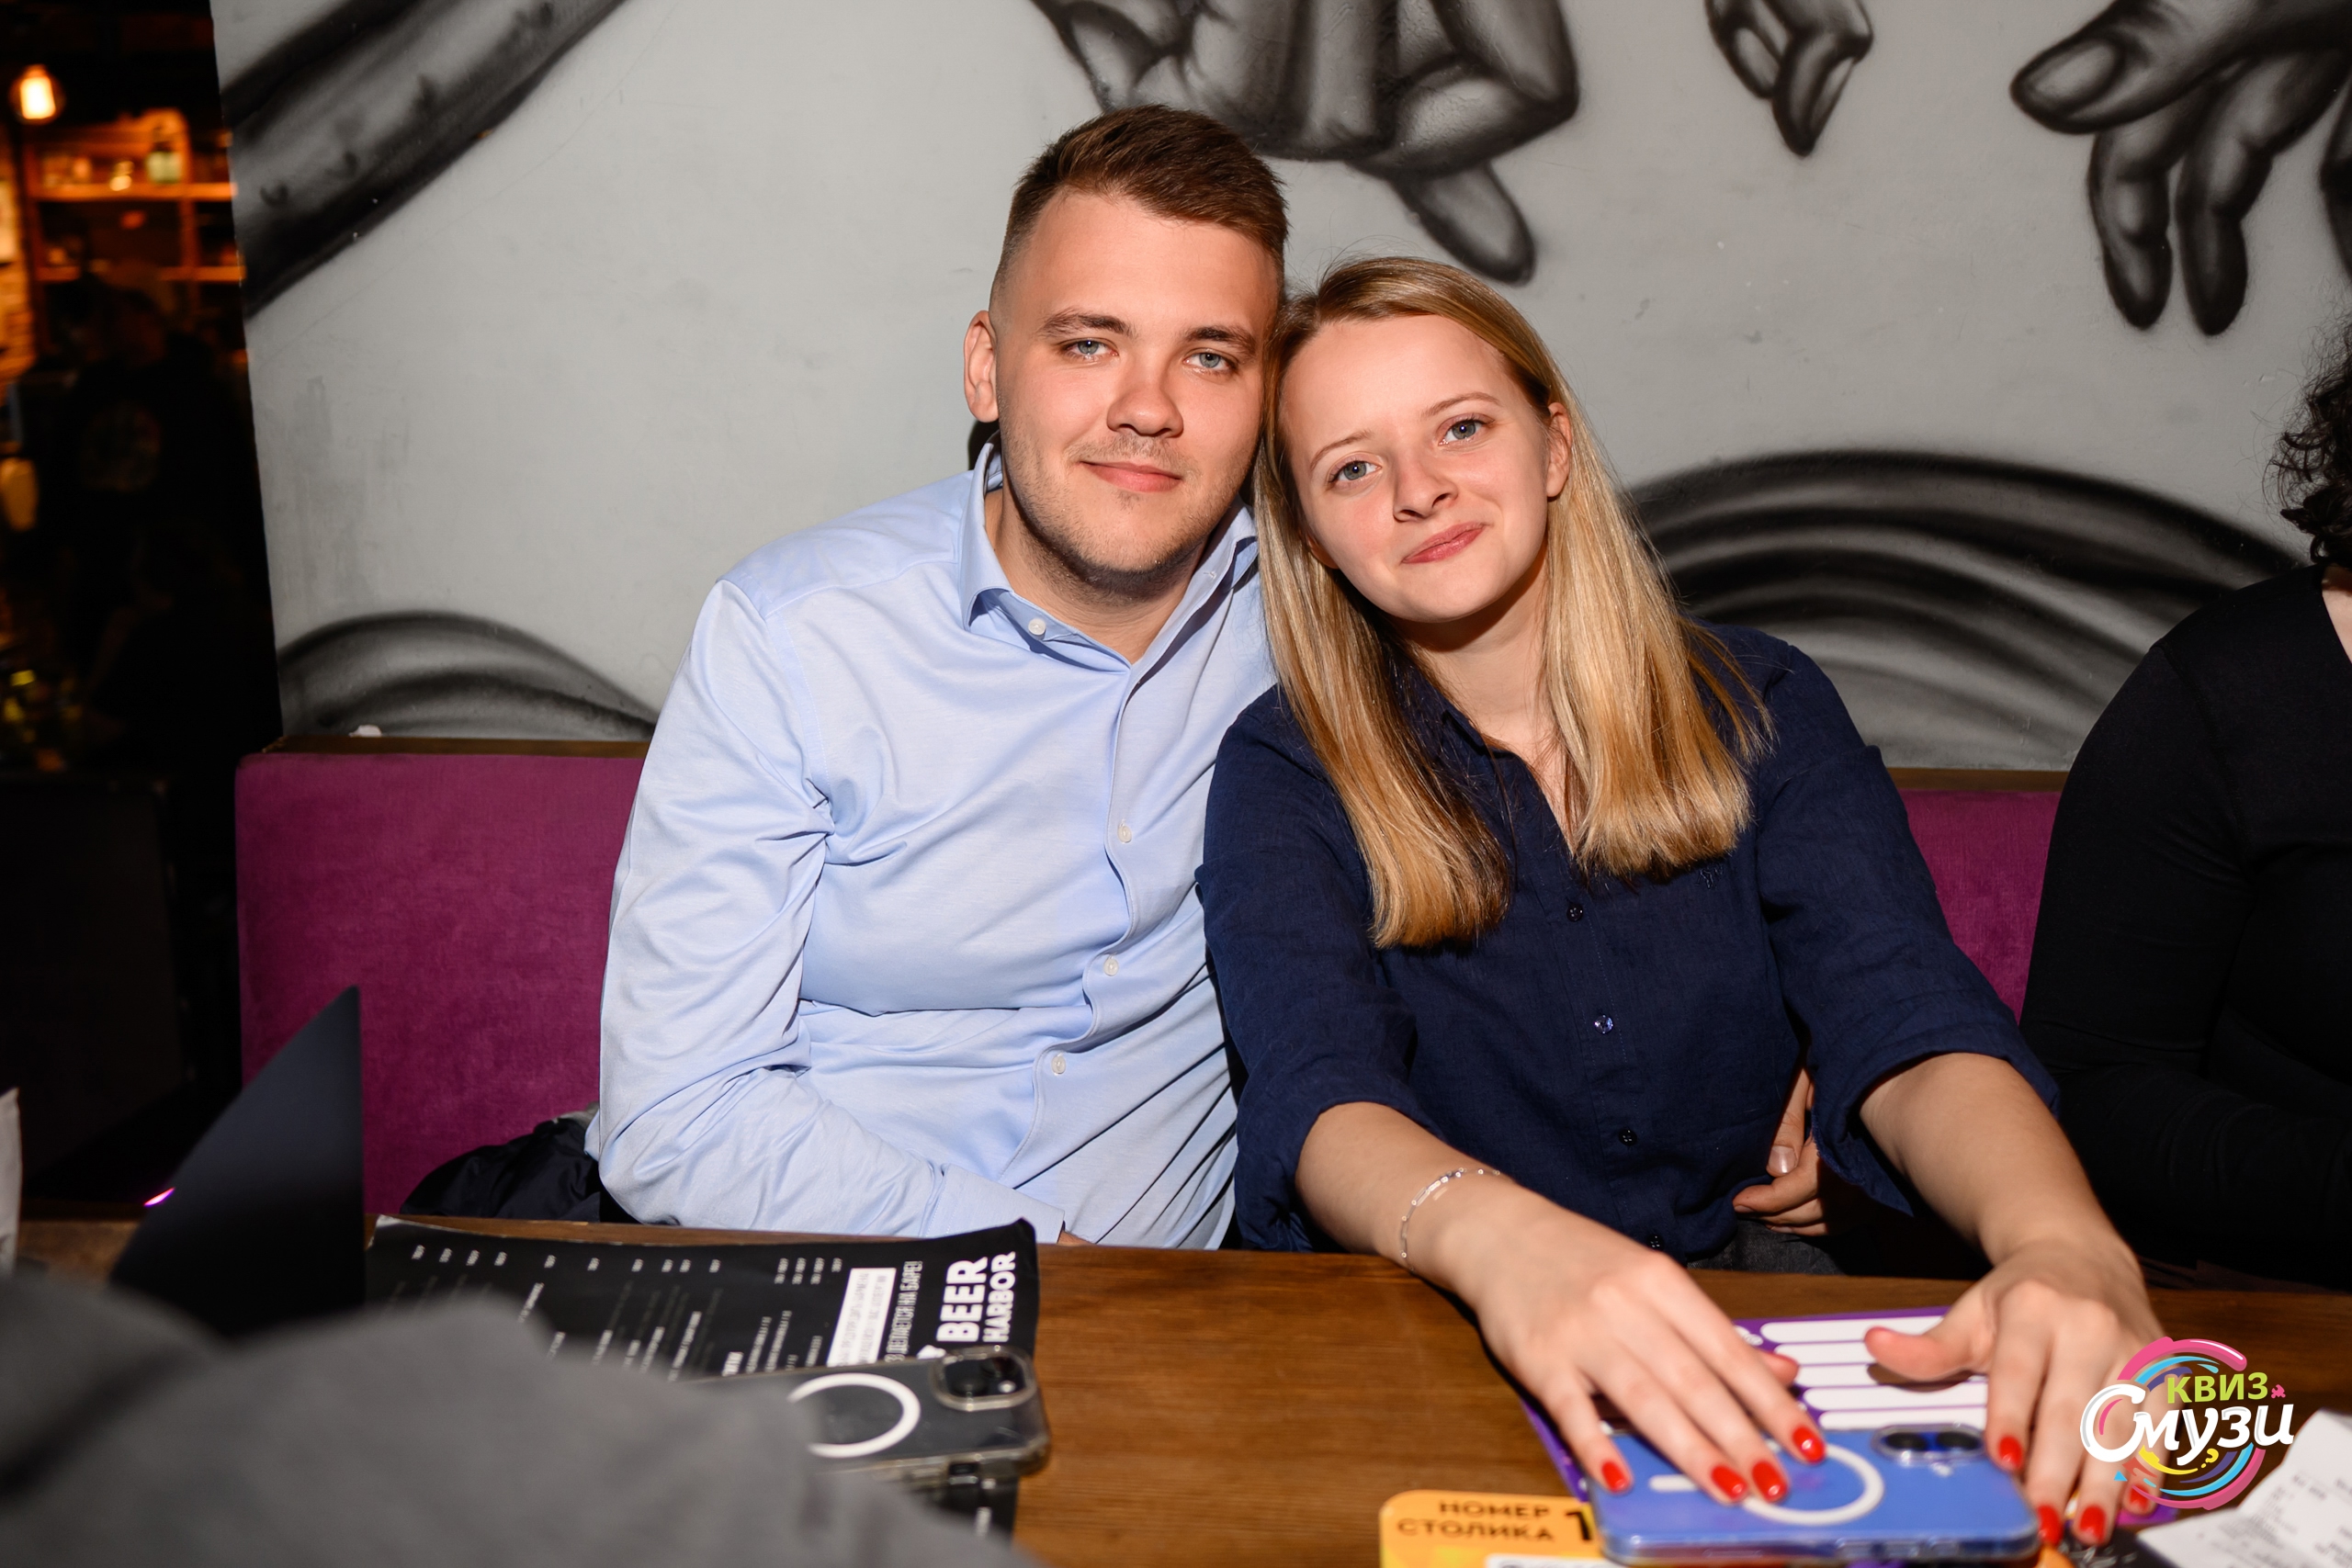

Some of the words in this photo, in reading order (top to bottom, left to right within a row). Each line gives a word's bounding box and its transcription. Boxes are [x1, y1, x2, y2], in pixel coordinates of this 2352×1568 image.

[936, 1257, 989, 1342] BEER
[982, 1251, 1016, 1342] HARBOR
[1396, 1517, 1555, 1541] СТОЛИКА
[1439, 1500, 1550, 1518] НОМЕР
